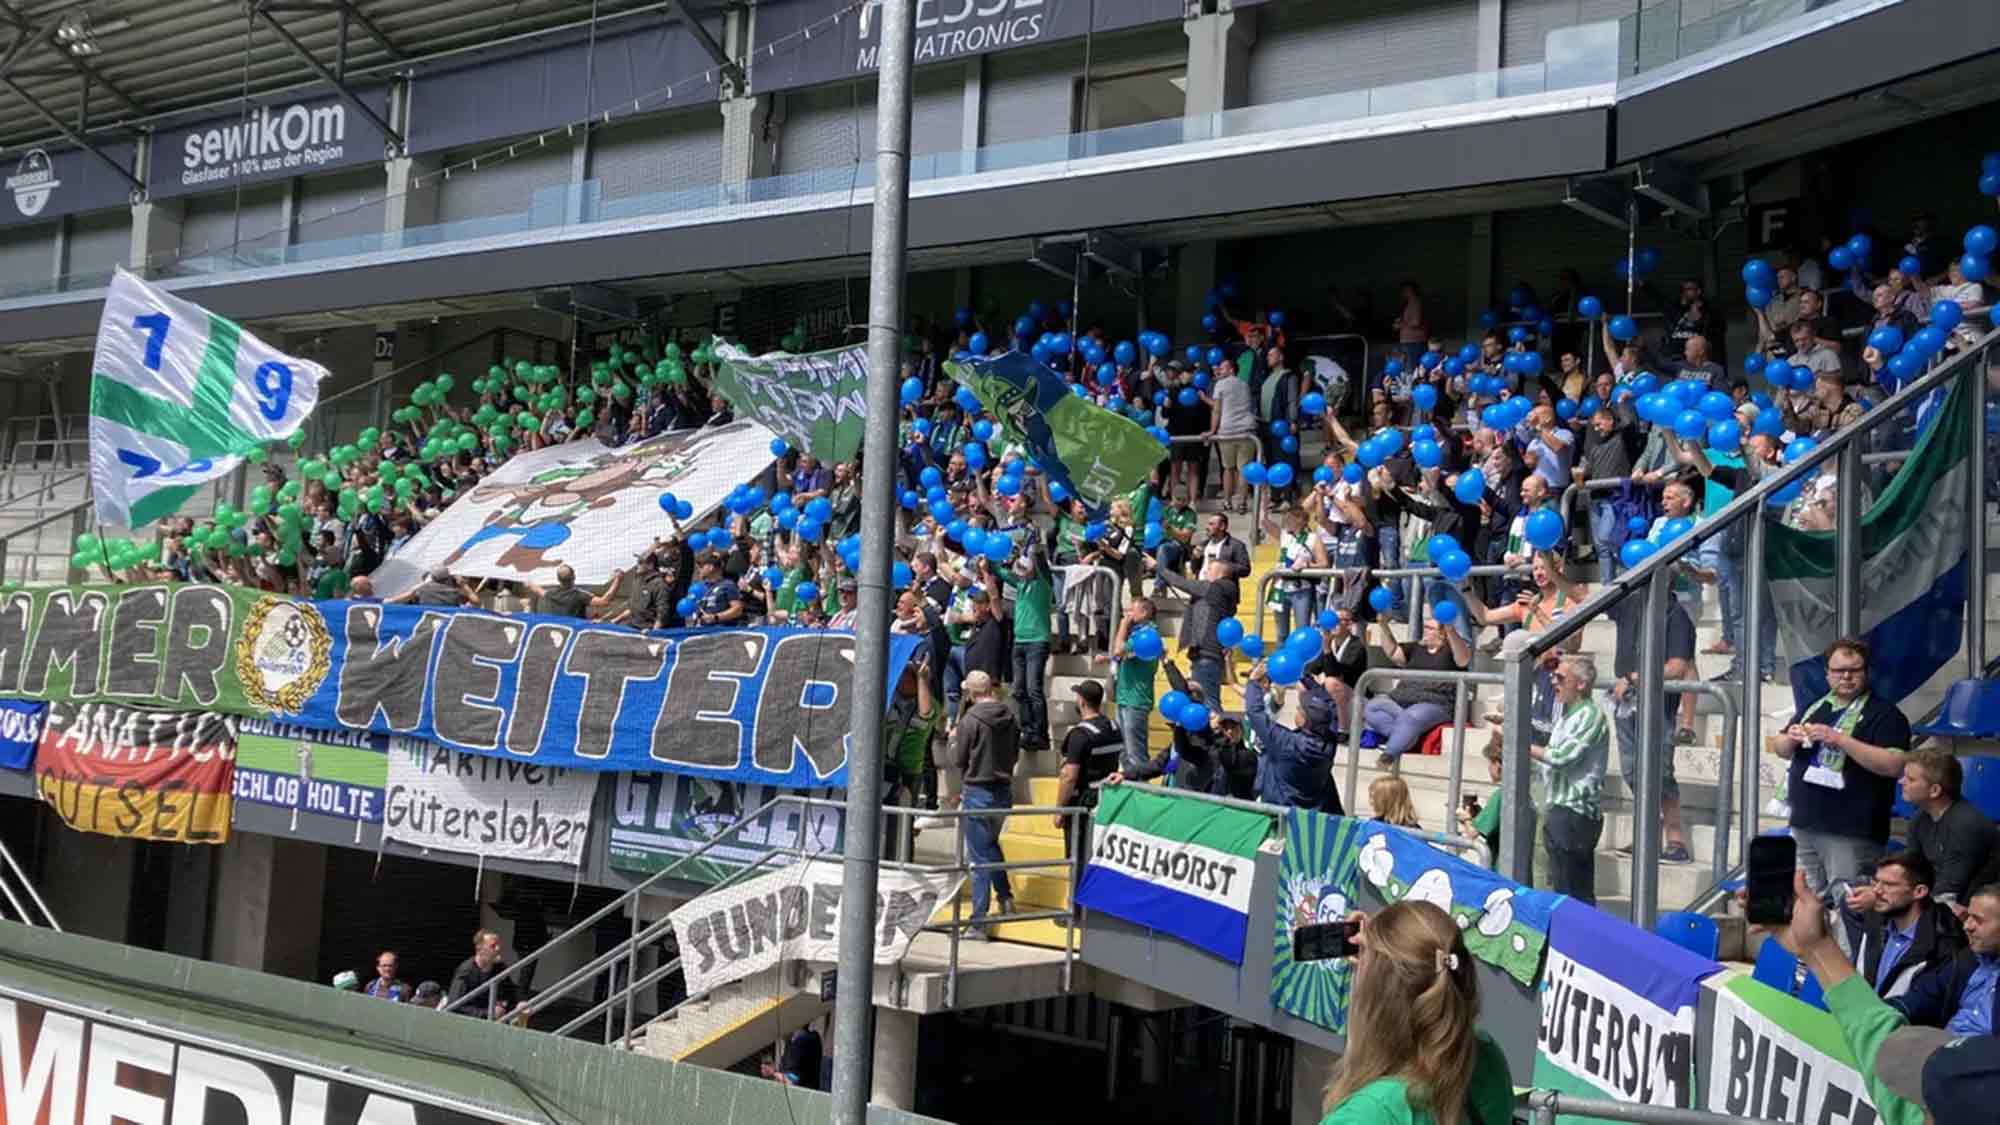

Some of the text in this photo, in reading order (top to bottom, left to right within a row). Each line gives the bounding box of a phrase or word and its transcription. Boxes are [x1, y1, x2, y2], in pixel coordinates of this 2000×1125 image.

[856, 14, 1042, 70] MATRONICS
[183, 103, 345, 168] sewikOm
[232, 158, 260, 176] 10%
[261, 157, 281, 171] aus
[283, 151, 303, 167] der
[304, 145, 343, 165] Region
[1762, 209, 1788, 243] F
[132, 311, 293, 422] 1 9
[335, 603, 858, 779] WEITER
[0, 706, 42, 743] OYS
[307, 781, 375, 820] HOLTE
[386, 785, 587, 850] Gütersloher
[687, 882, 938, 974] SUNDEN
[0, 998, 418, 1125] MED
[1725, 1015, 1878, 1125] BIEL
